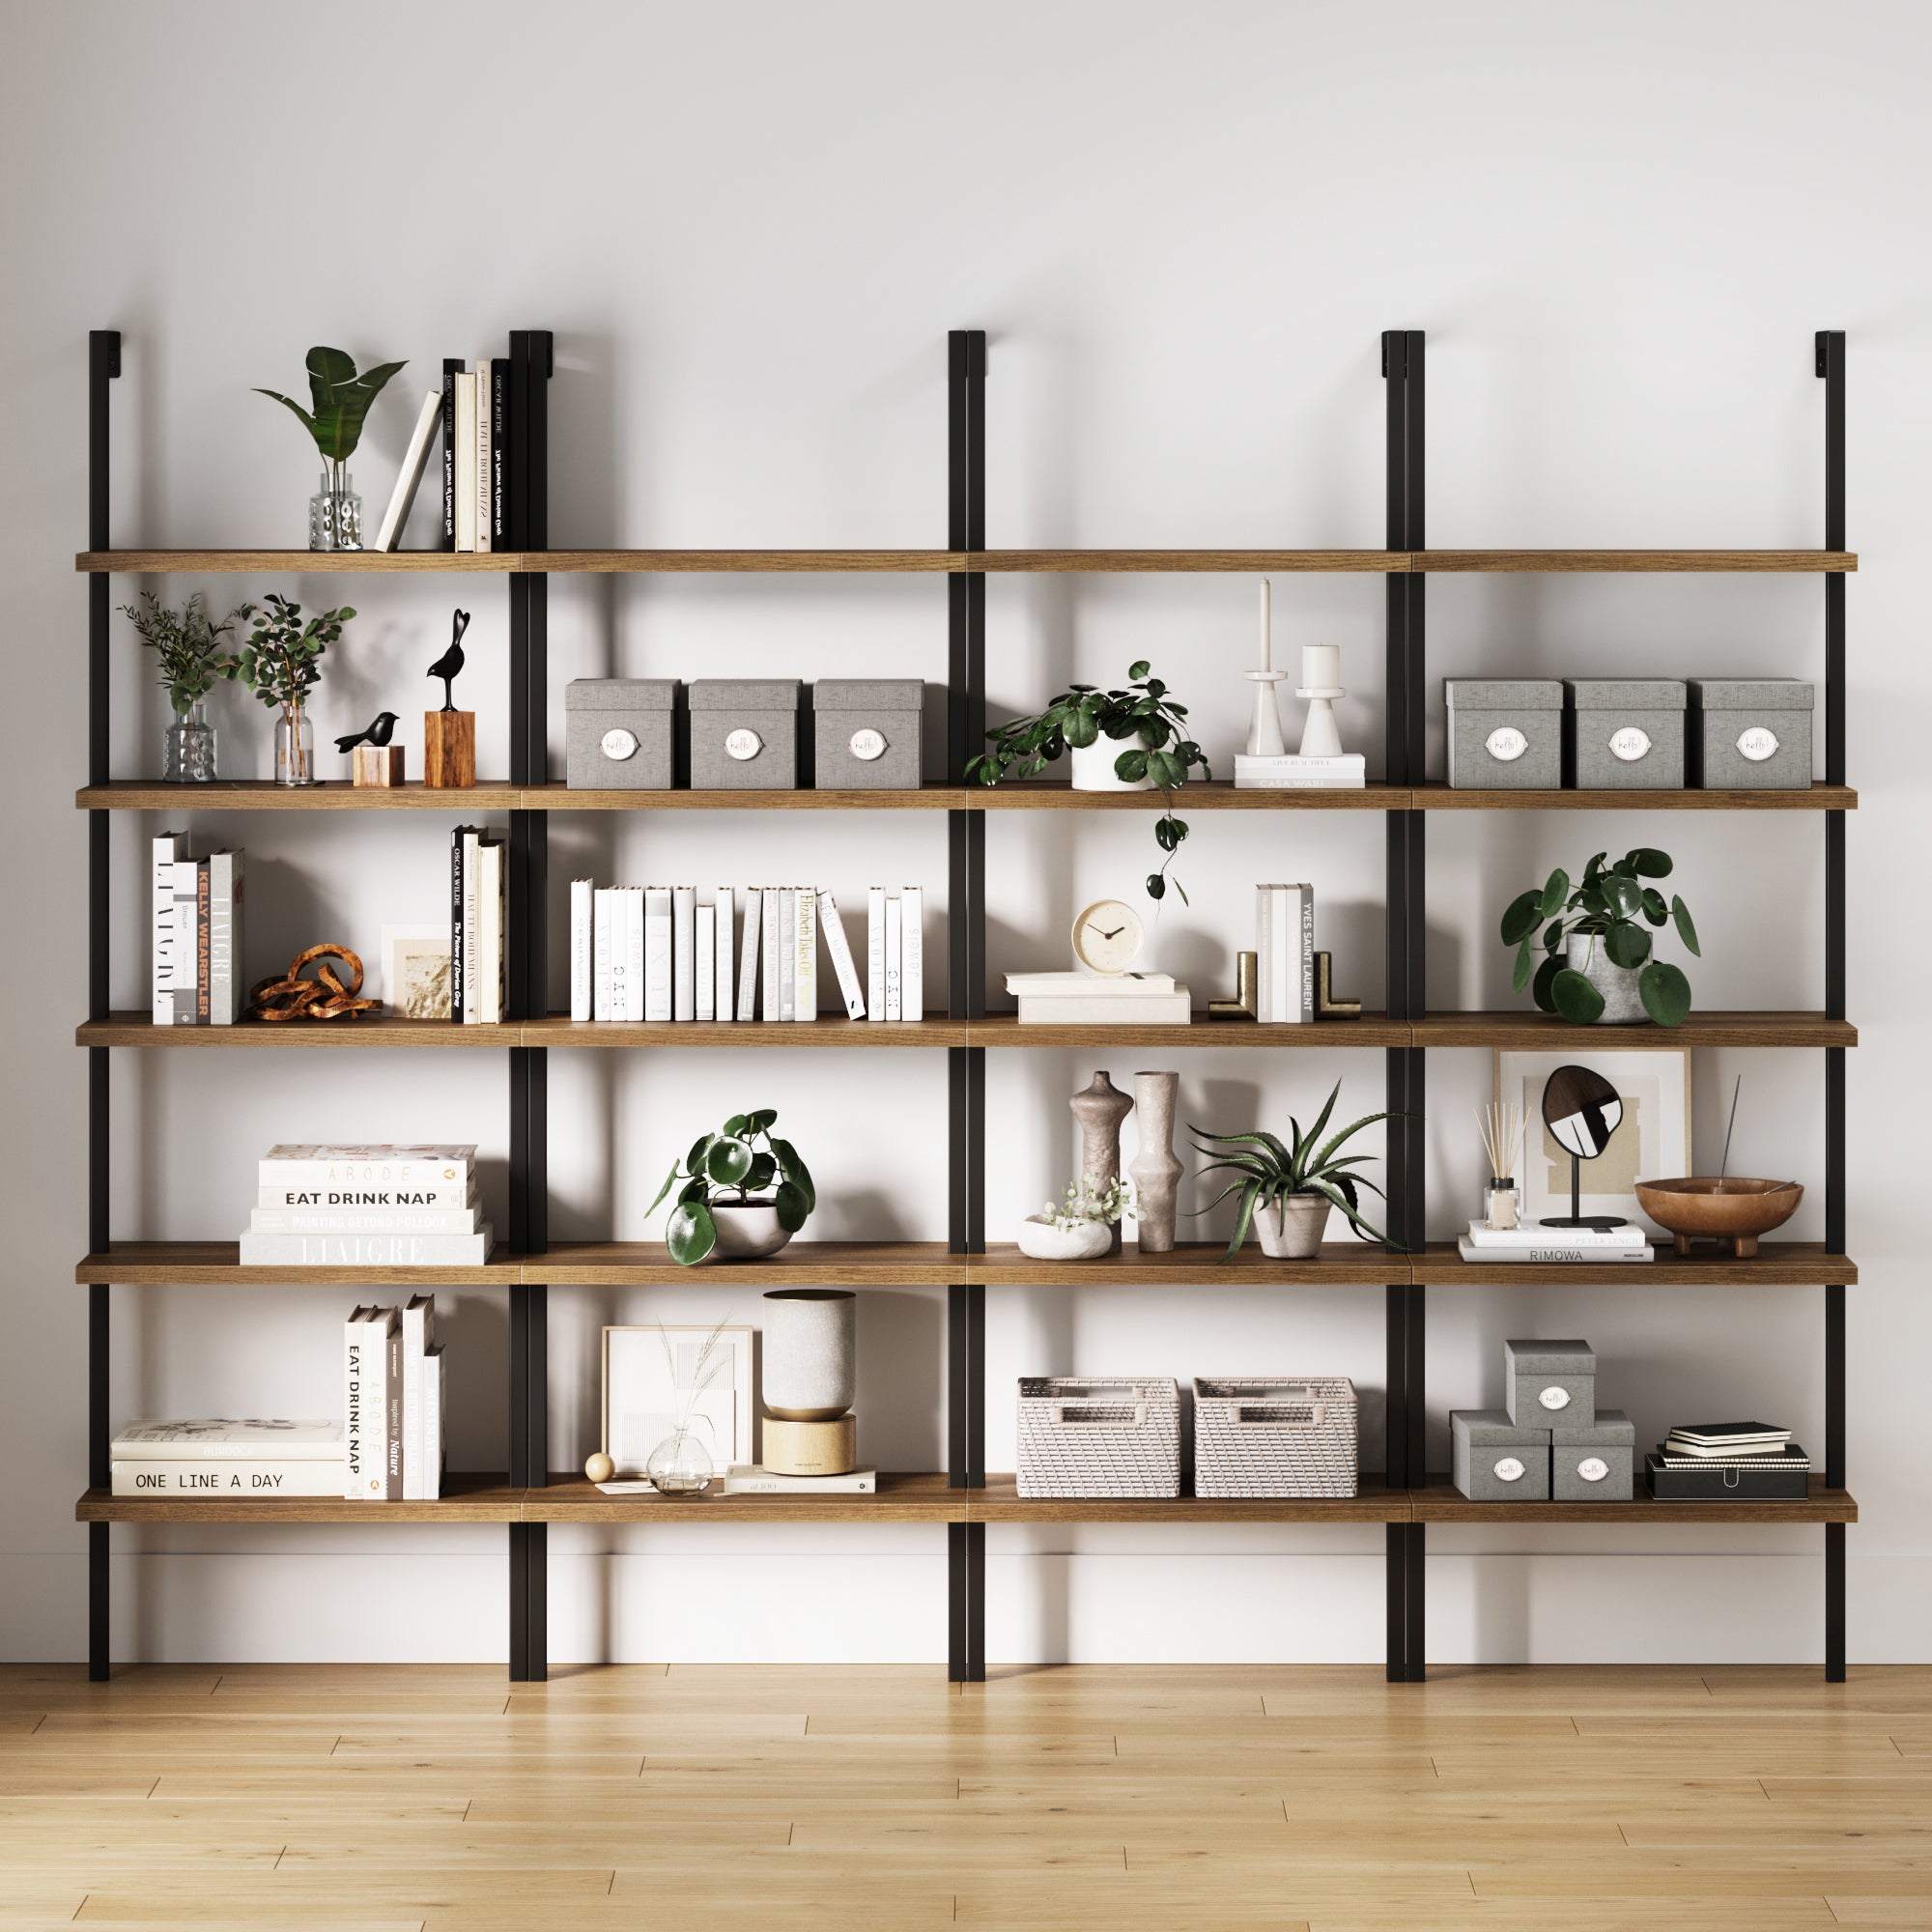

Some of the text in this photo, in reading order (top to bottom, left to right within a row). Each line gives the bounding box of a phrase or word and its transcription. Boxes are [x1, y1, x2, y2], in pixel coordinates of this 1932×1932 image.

[799, 895, 814, 935] Elizabeth
[199, 871, 209, 1015] KELLY WEARSTLER
[212, 897, 230, 983] LIAIGRE
[630, 927, 641, 978] Jewels
[799, 936, 814, 959] Takes
[905, 927, 920, 979] Jewels
[1303, 902, 1312, 1011] YVES SAINT LAURENT
[613, 966, 624, 1008] NYC
[798, 961, 813, 978] Off
[889, 970, 898, 1009] NYC
[328, 1167, 410, 1180] ABODE
[286, 1193, 321, 1205] EAT
[328, 1193, 390, 1205] DRINK
[396, 1193, 437, 1205] NAP
[293, 1216, 345, 1229] PAINTING
[348, 1216, 393, 1229] BEYOND
[1530, 1250, 1583, 1261] RIMOWA
[350, 1346, 359, 1474] EAT DRINK NAP
[390, 1399, 400, 1476] Inspired by Nature
[135, 1474, 284, 1489] ONE LINE A DAY
